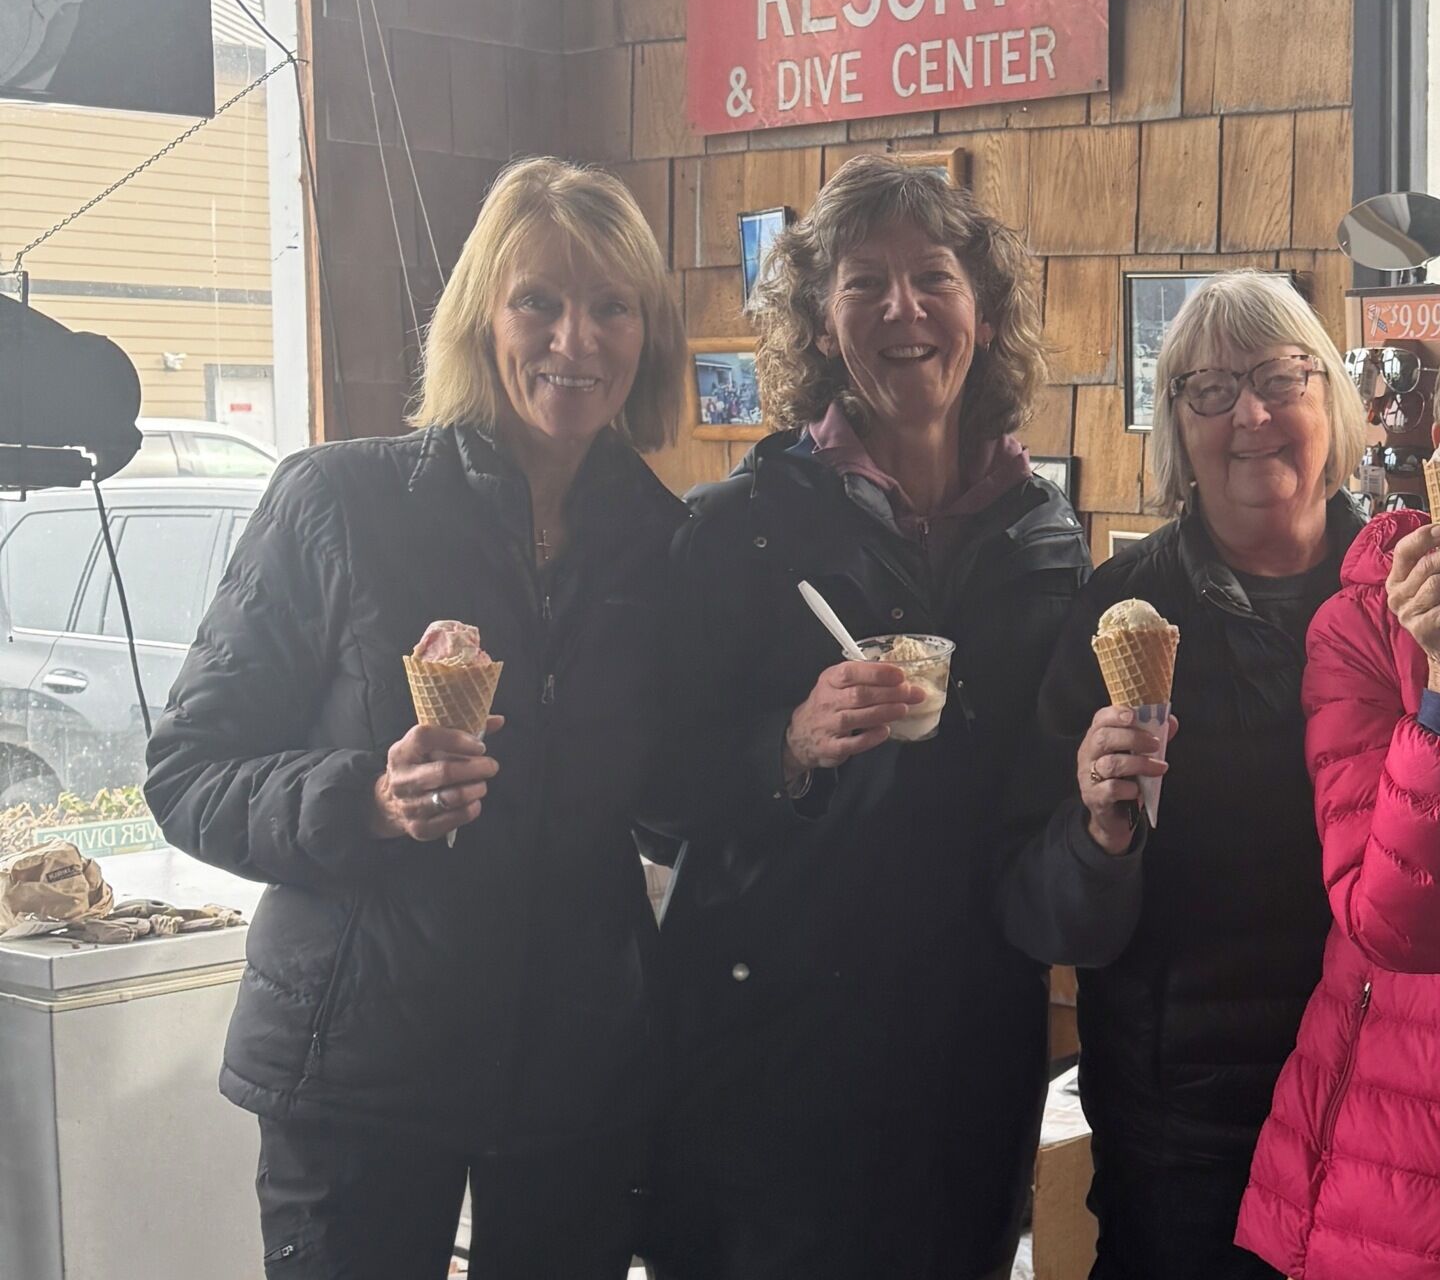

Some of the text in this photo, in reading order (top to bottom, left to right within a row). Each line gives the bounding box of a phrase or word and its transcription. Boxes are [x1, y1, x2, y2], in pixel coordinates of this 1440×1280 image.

[726, 26, 1057, 118] & DIVE CENTER
